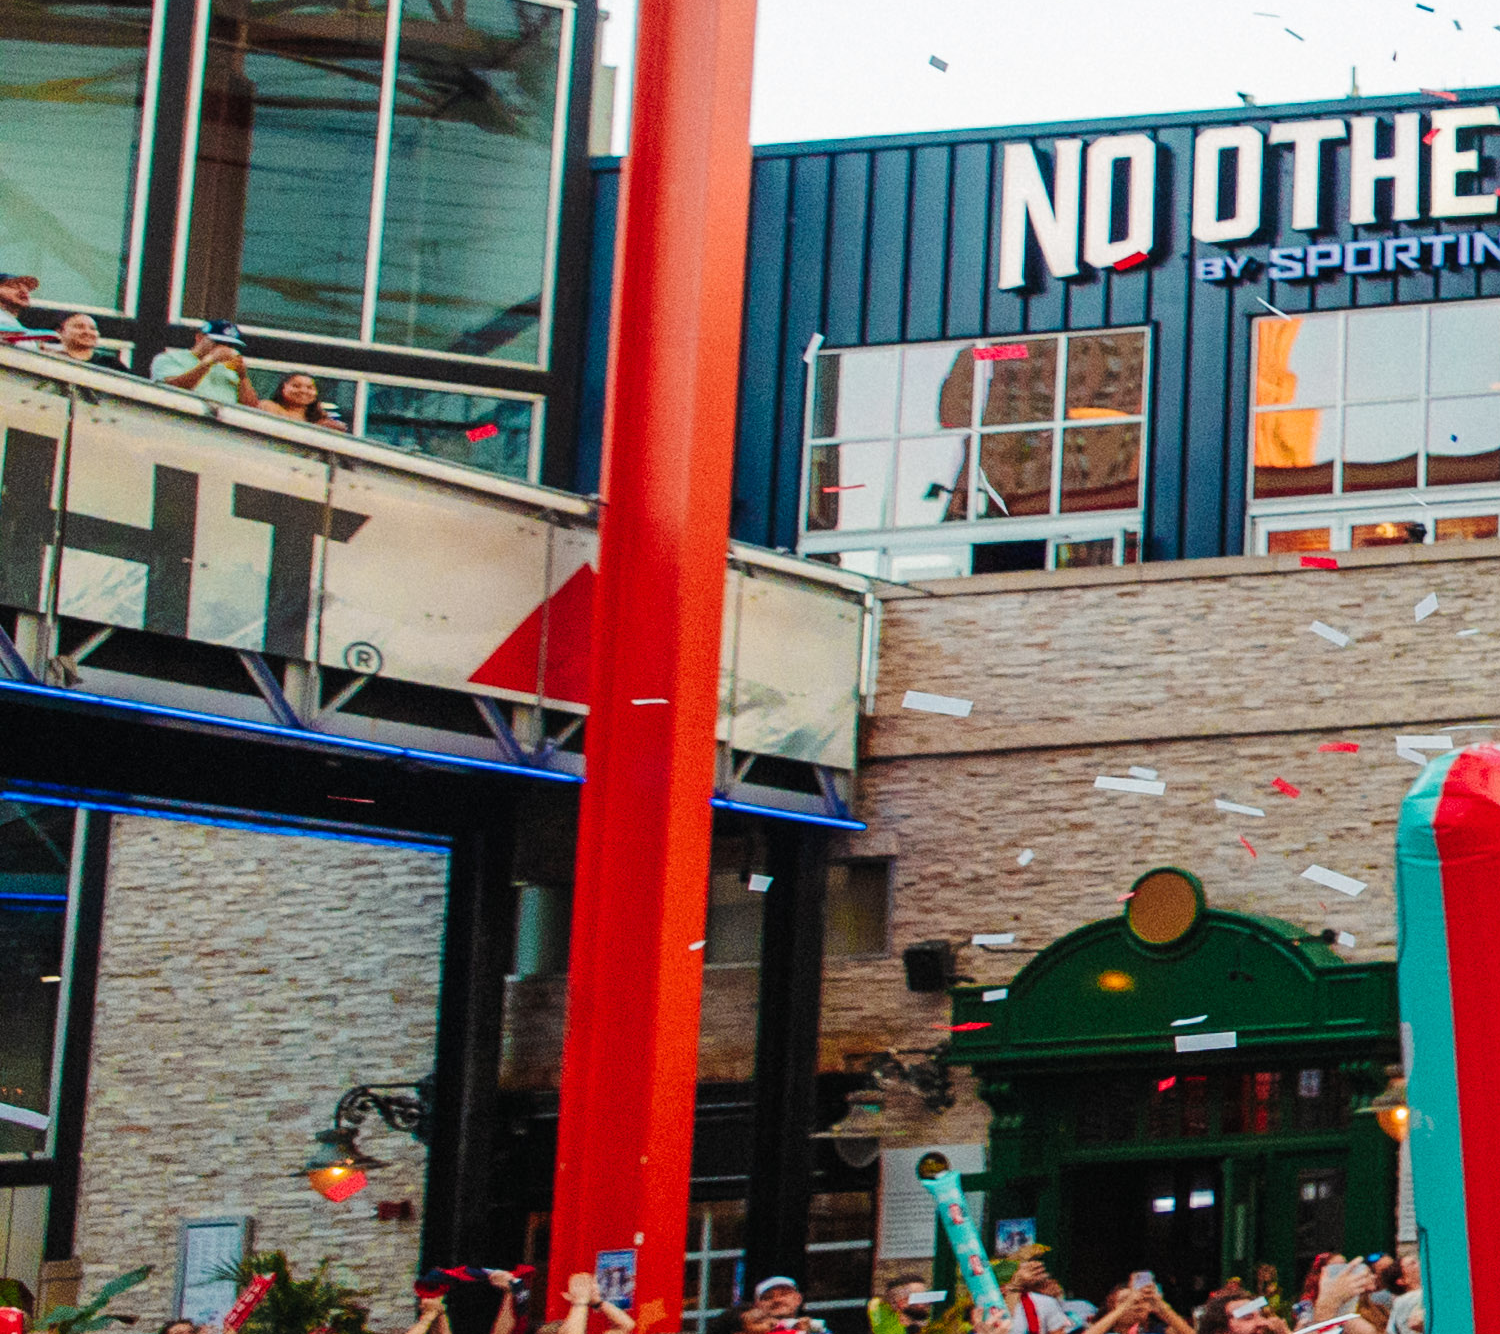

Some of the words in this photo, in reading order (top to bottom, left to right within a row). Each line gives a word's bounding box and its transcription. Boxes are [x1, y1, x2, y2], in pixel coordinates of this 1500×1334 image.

[998, 133, 1156, 291] NO
[1200, 256, 1244, 281] BY
[0, 427, 372, 661] HT
